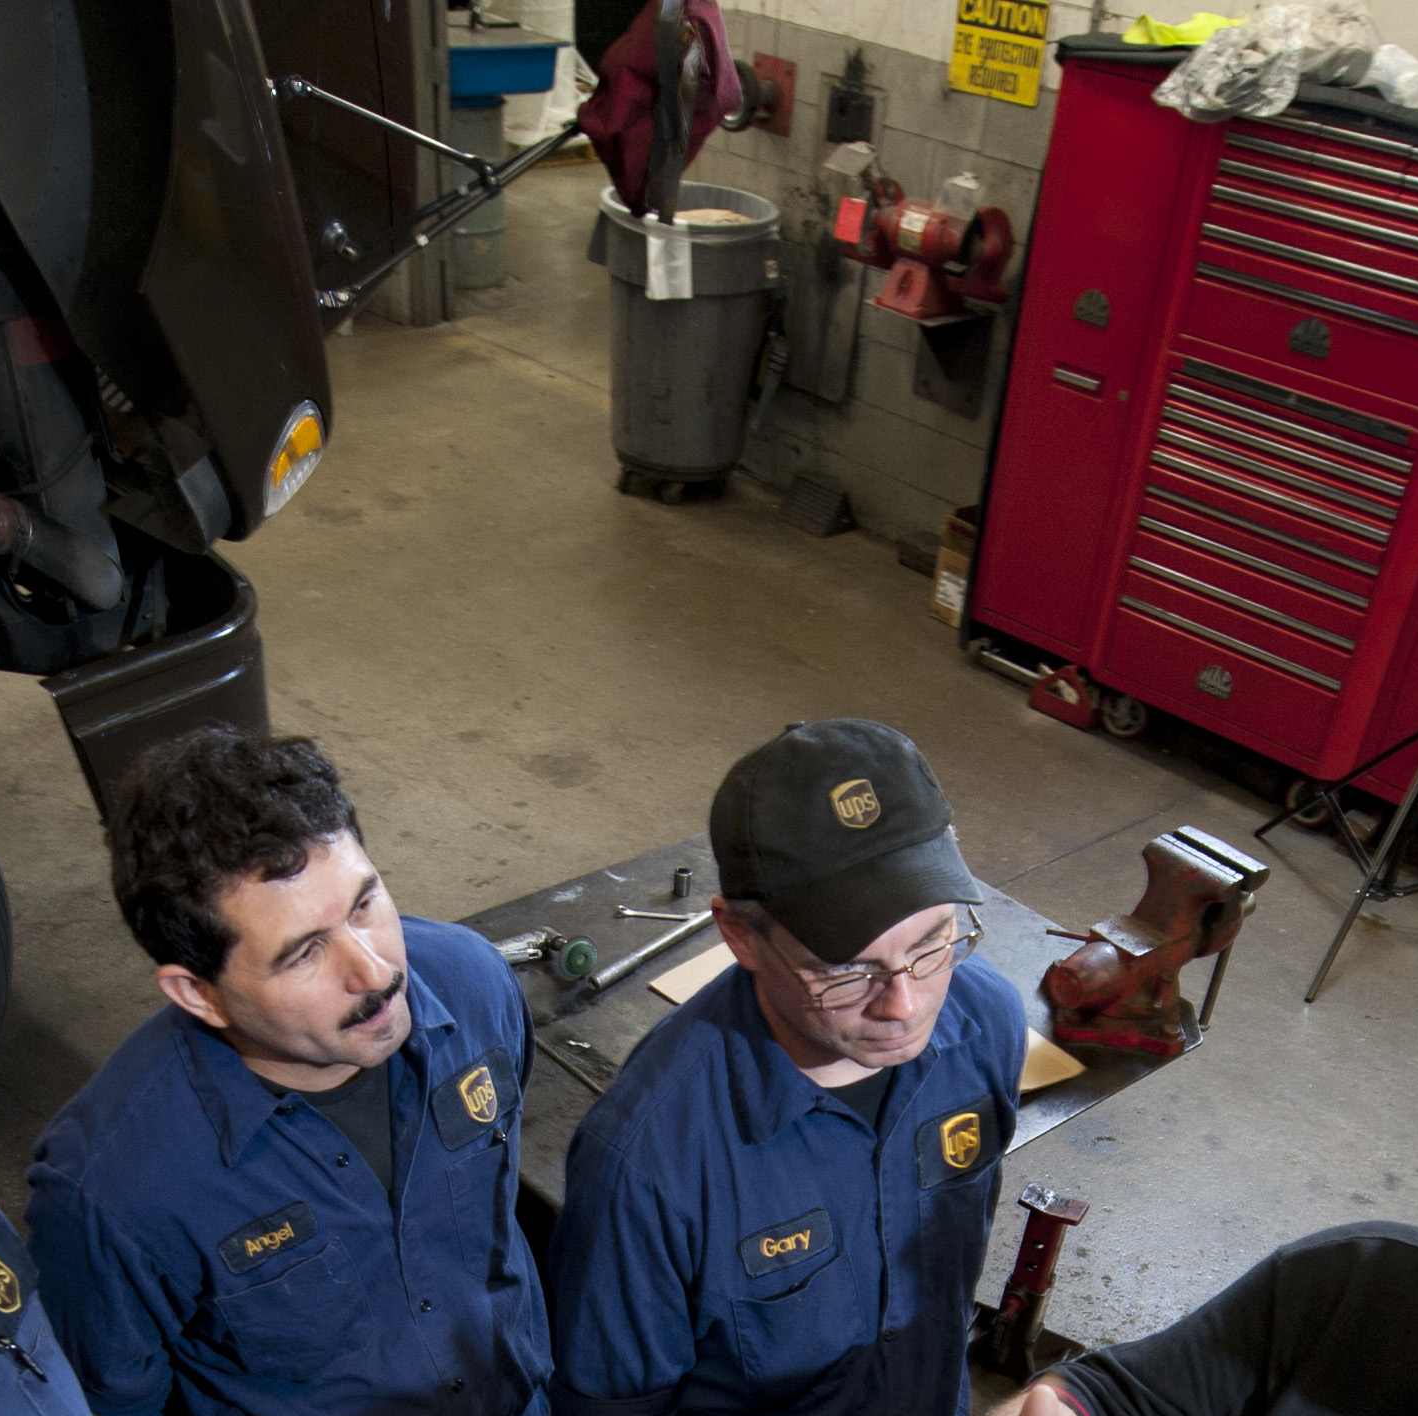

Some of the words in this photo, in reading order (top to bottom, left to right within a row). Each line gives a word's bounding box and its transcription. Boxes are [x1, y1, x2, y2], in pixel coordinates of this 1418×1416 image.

[960, 0, 1047, 37] CAUTION
[979, 36, 1040, 69] PROTECTION
[968, 64, 1019, 95] REQUIRED
[244, 1221, 295, 1258] Angel
[759, 1228, 811, 1258] Gary
